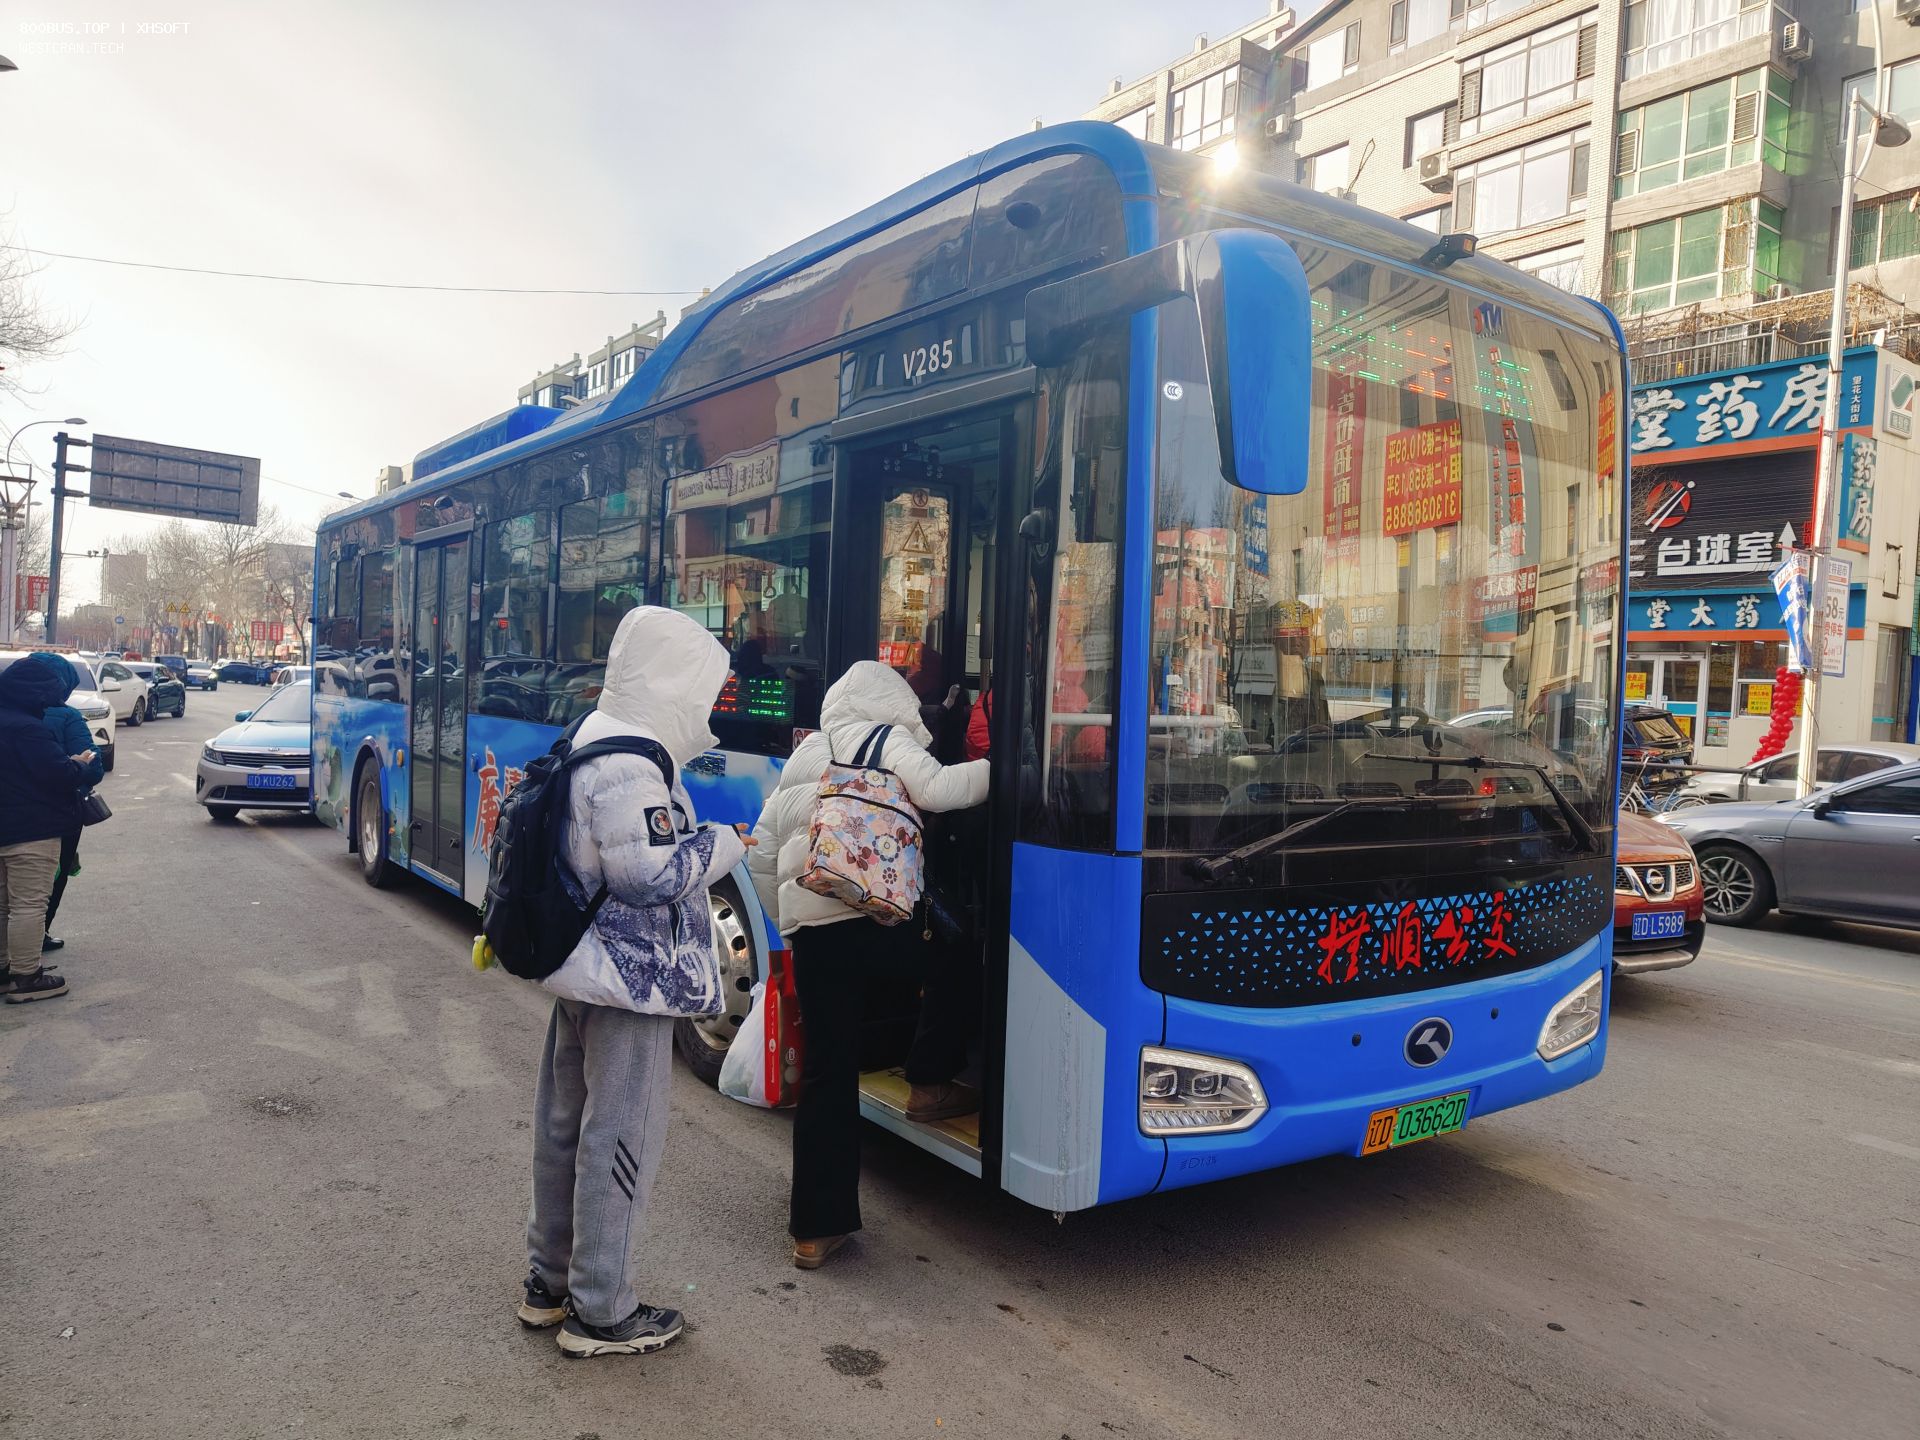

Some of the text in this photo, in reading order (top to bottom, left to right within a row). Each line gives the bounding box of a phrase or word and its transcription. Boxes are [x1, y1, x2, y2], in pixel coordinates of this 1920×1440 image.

[902, 338, 953, 380] V285
[1849, 375, 1863, 424] 望花大街店
[1647, 594, 1788, 629] 堂大药
